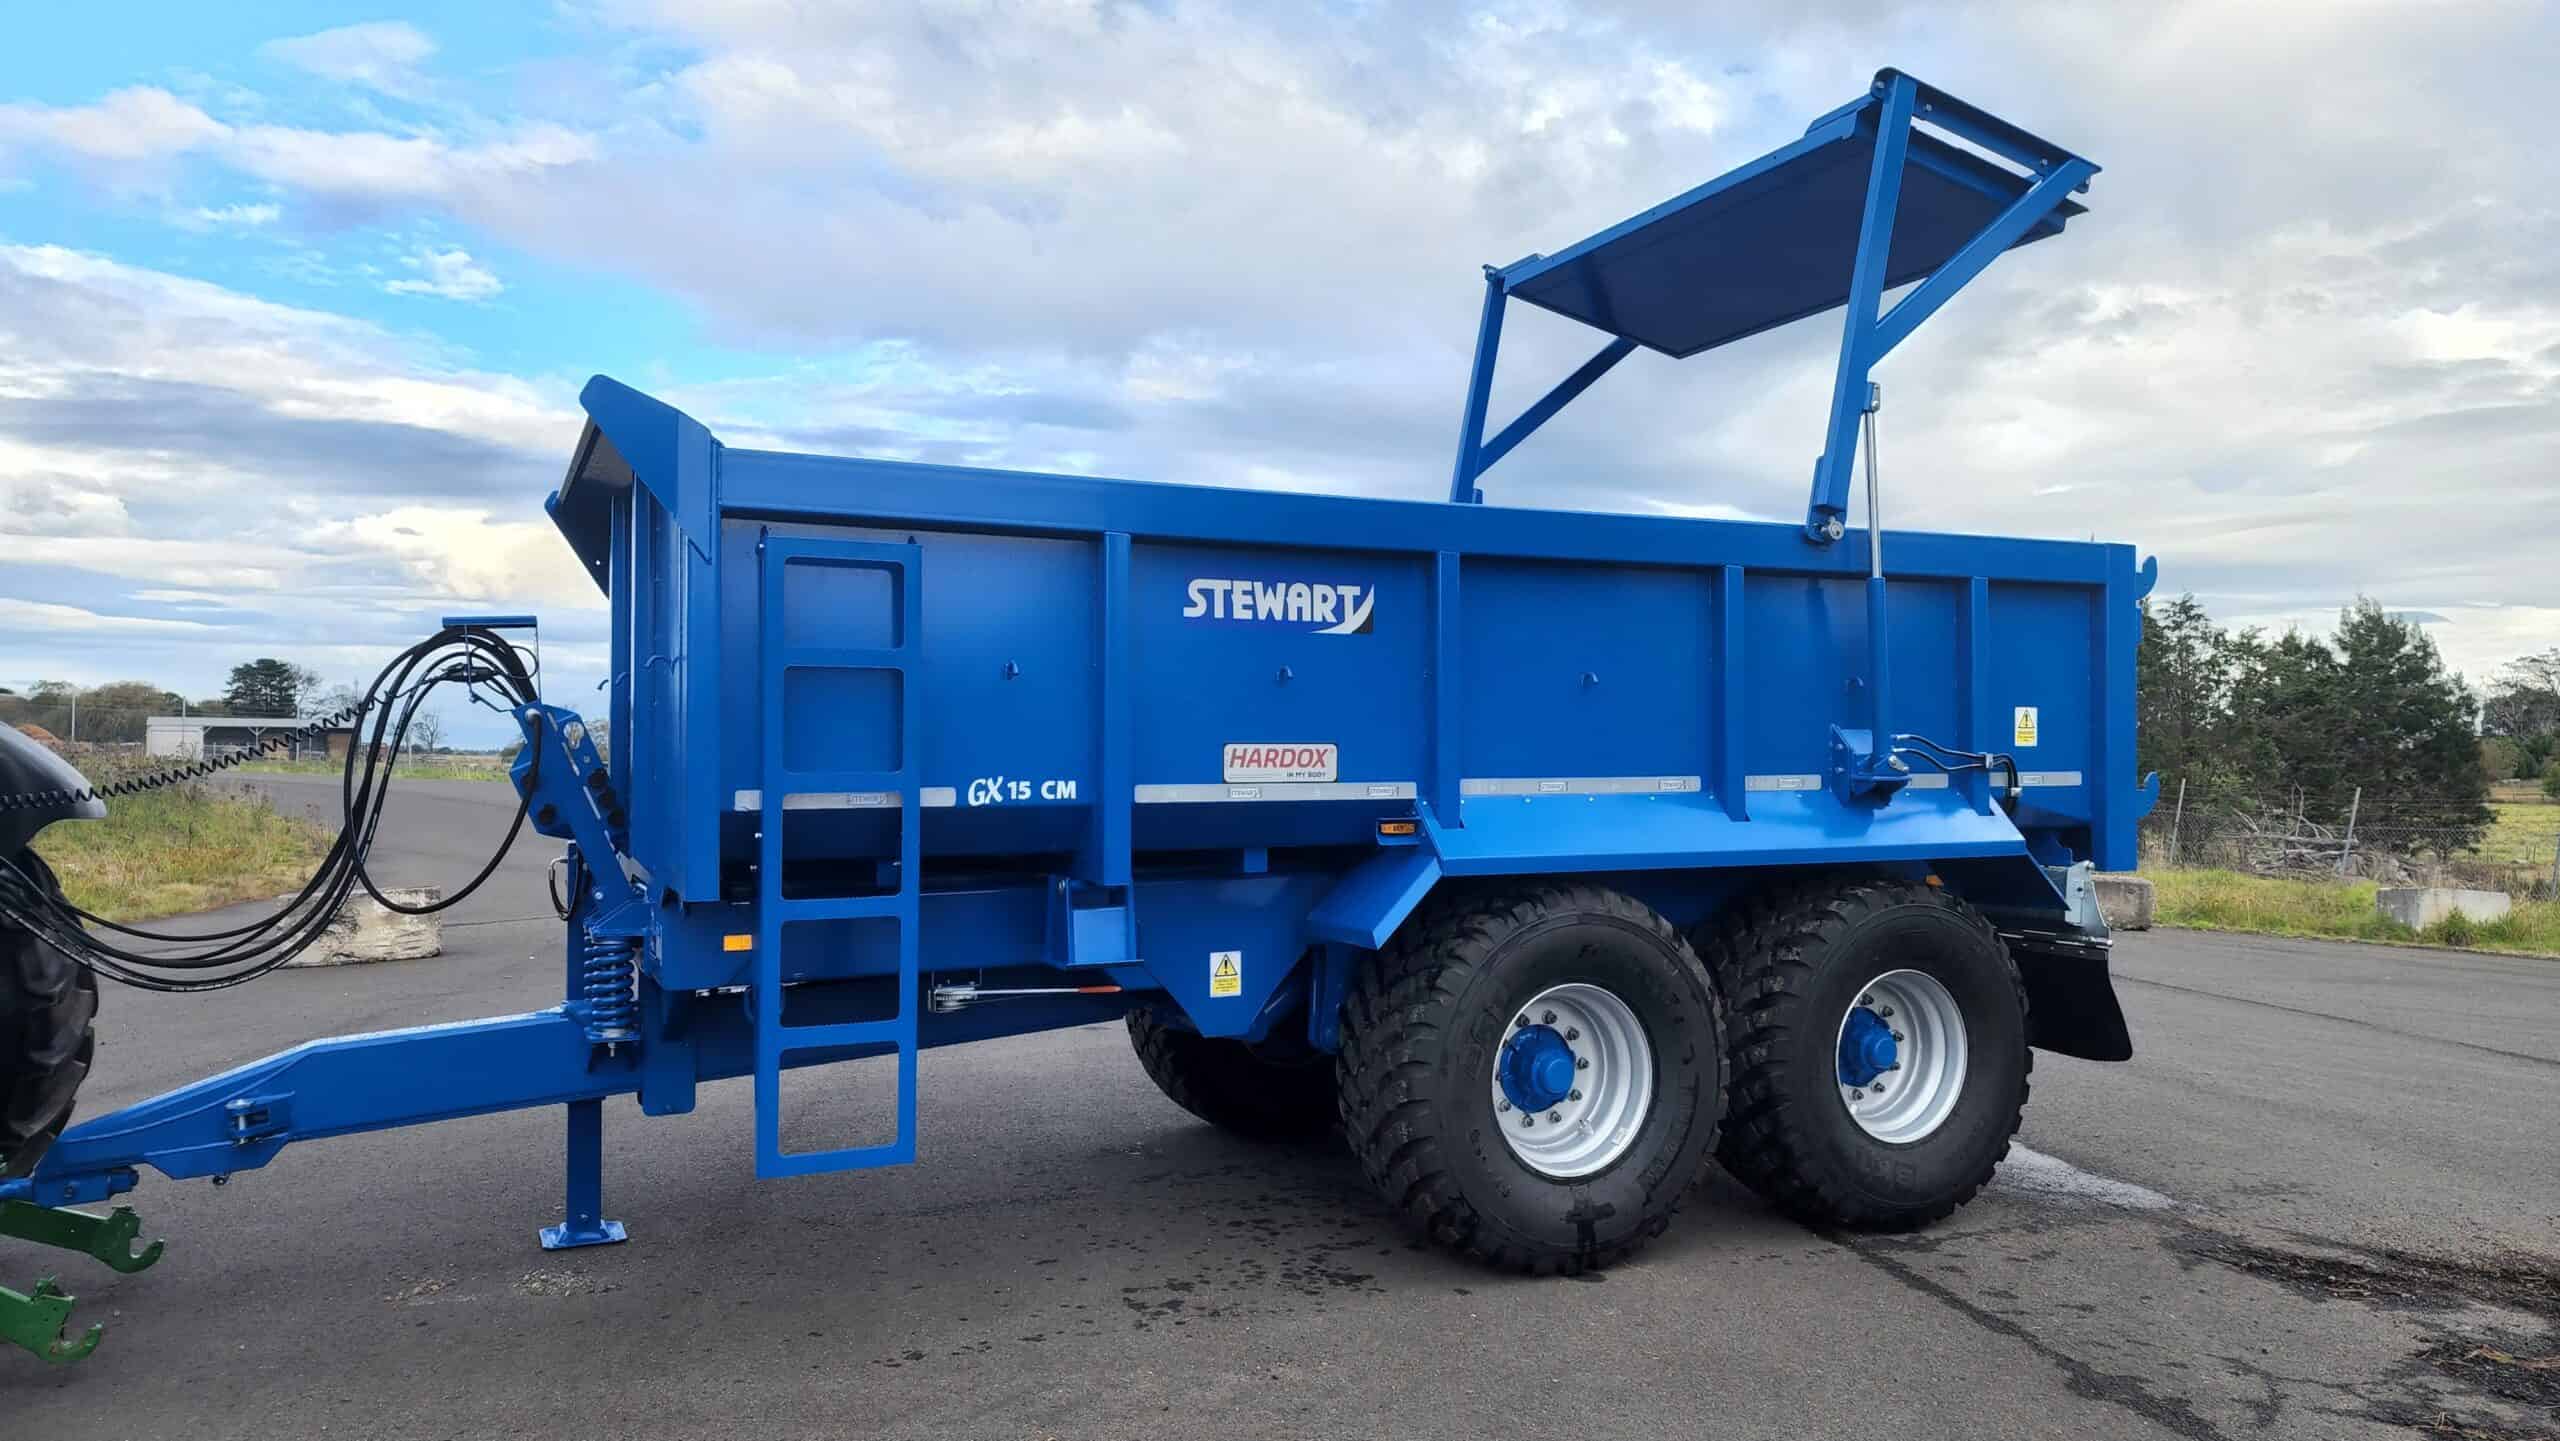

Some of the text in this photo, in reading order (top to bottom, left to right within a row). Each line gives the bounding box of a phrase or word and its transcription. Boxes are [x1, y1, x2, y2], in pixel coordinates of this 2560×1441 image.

[1183, 578, 1375, 634] STEWART
[1229, 748, 1329, 769] HARDOX
[967, 775, 1076, 807] GX 15 CM
